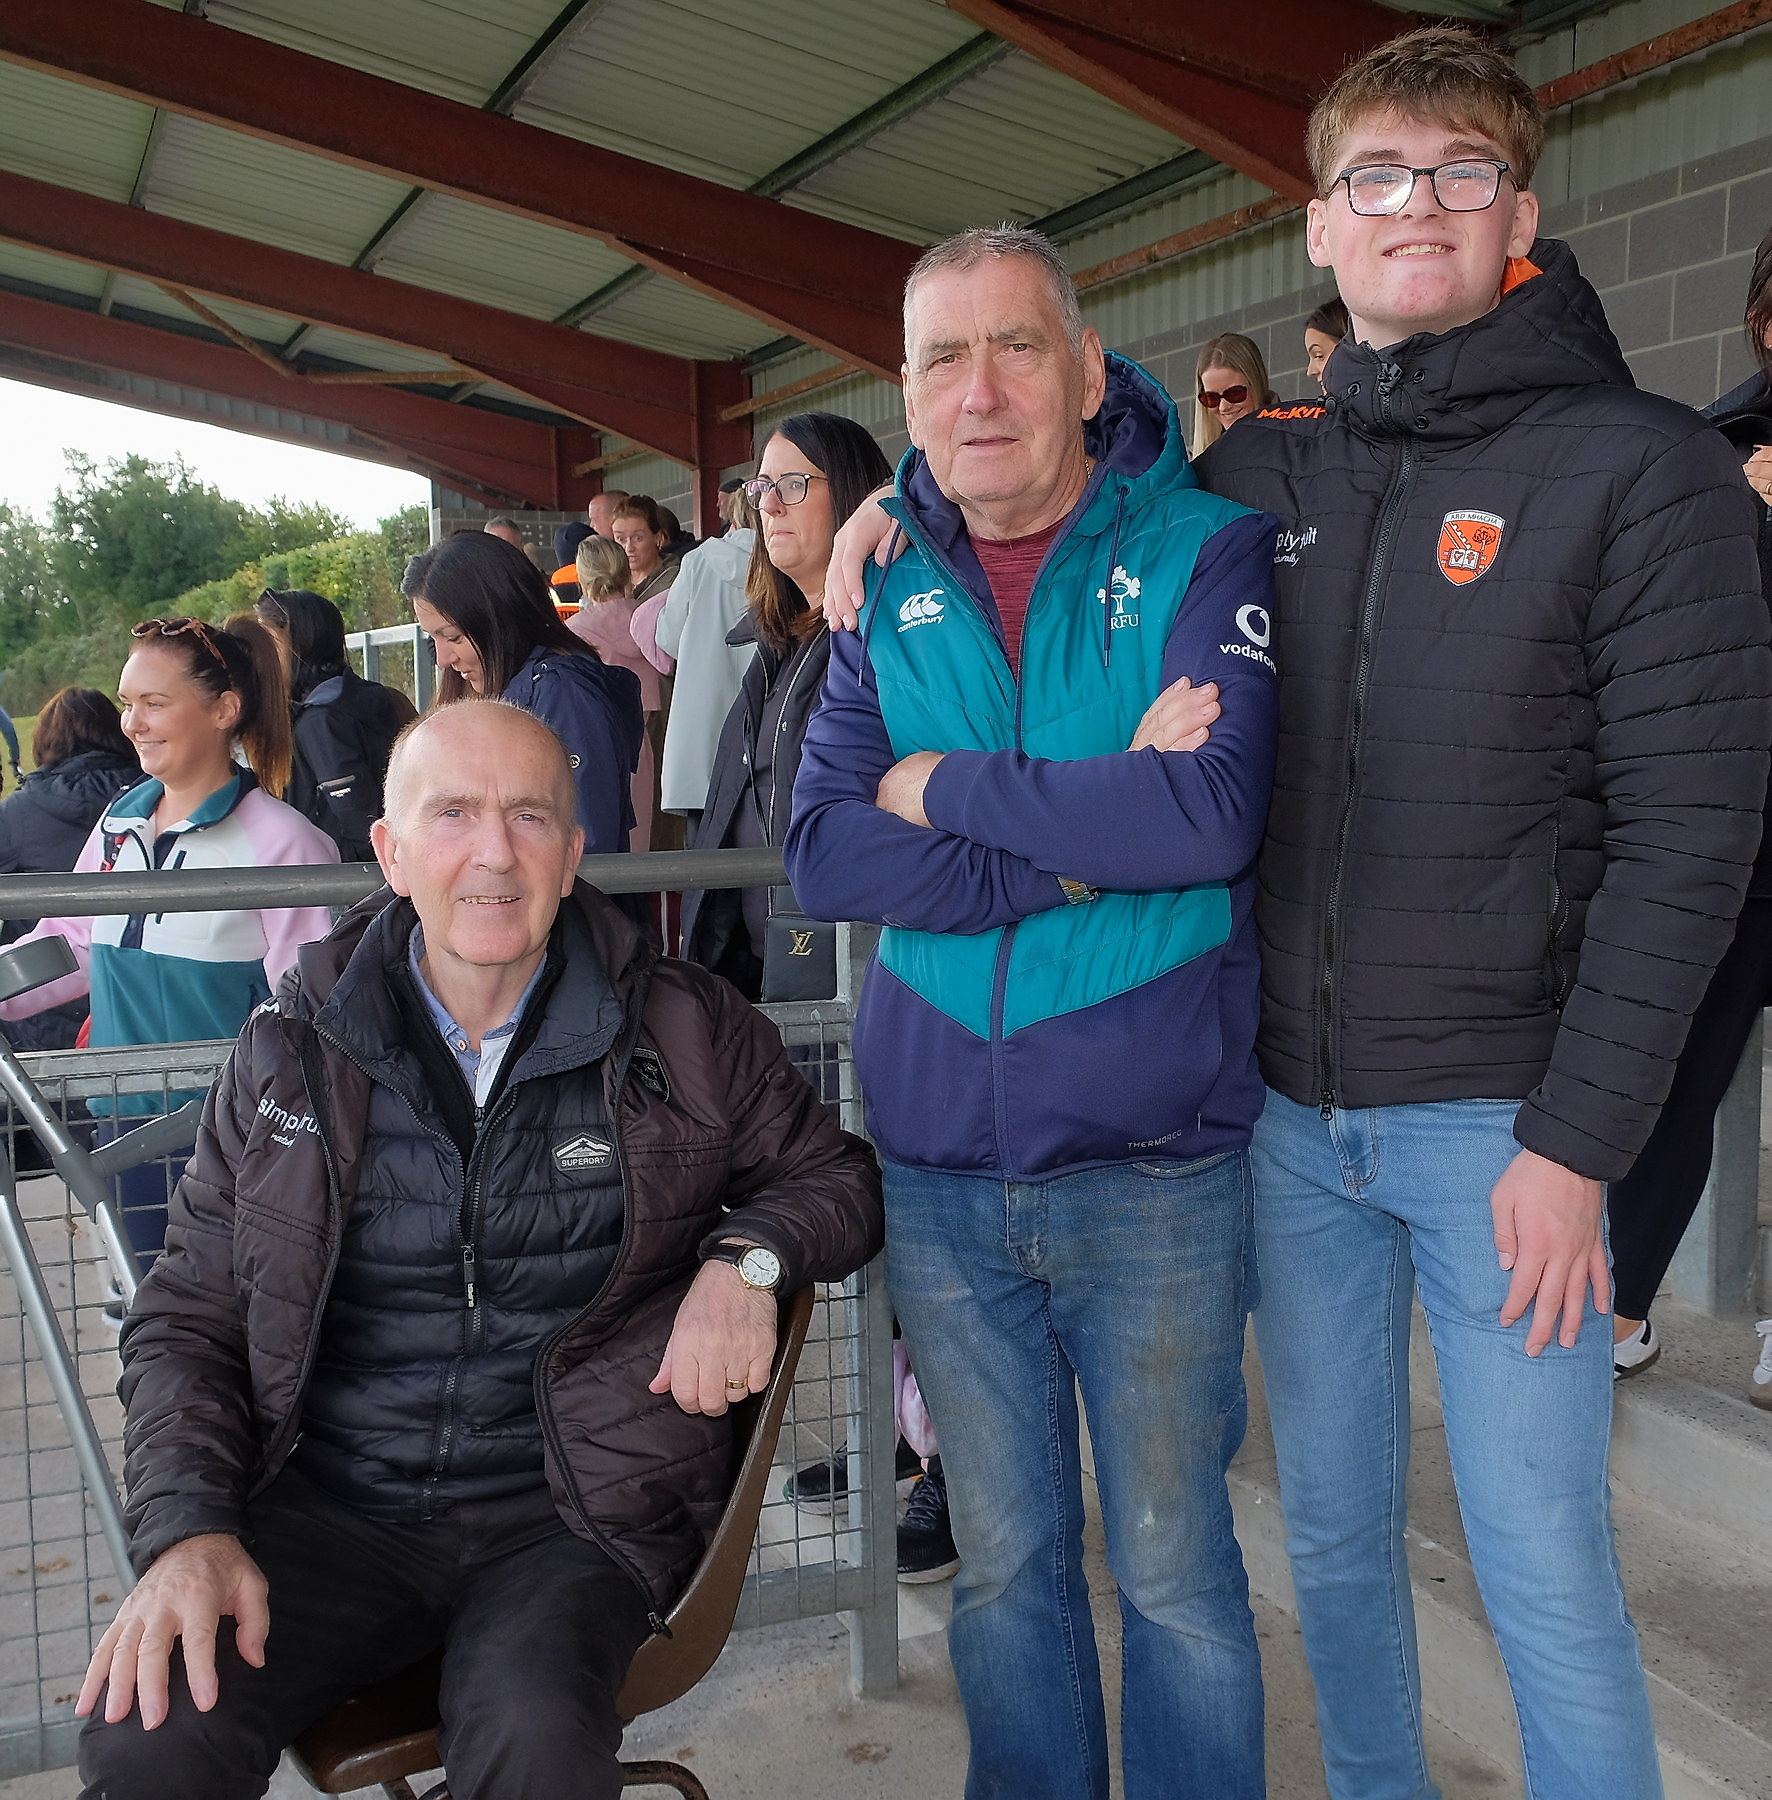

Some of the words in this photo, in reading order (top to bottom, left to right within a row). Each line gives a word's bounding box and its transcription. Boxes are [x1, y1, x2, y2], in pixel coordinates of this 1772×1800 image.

[1110, 613, 1139, 630] RFU
[1219, 644, 1277, 676] vodafon
[561, 1156, 606, 1167] SUPERDRY
